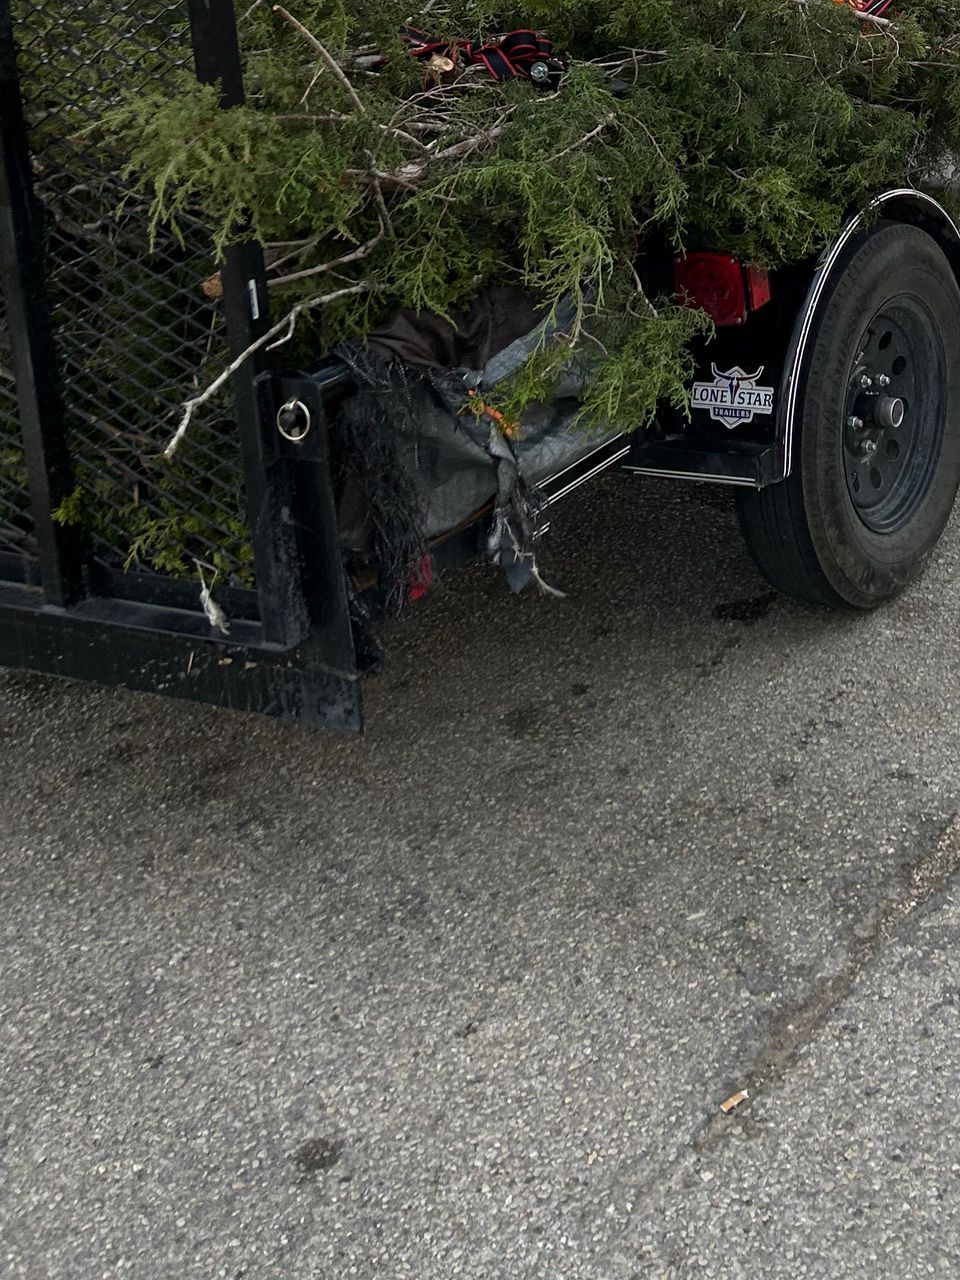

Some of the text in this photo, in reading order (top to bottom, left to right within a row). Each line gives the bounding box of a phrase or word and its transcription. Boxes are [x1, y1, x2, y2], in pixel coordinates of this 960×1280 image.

[693, 388, 772, 407] LONE STAR
[714, 408, 751, 418] TRAILERS
